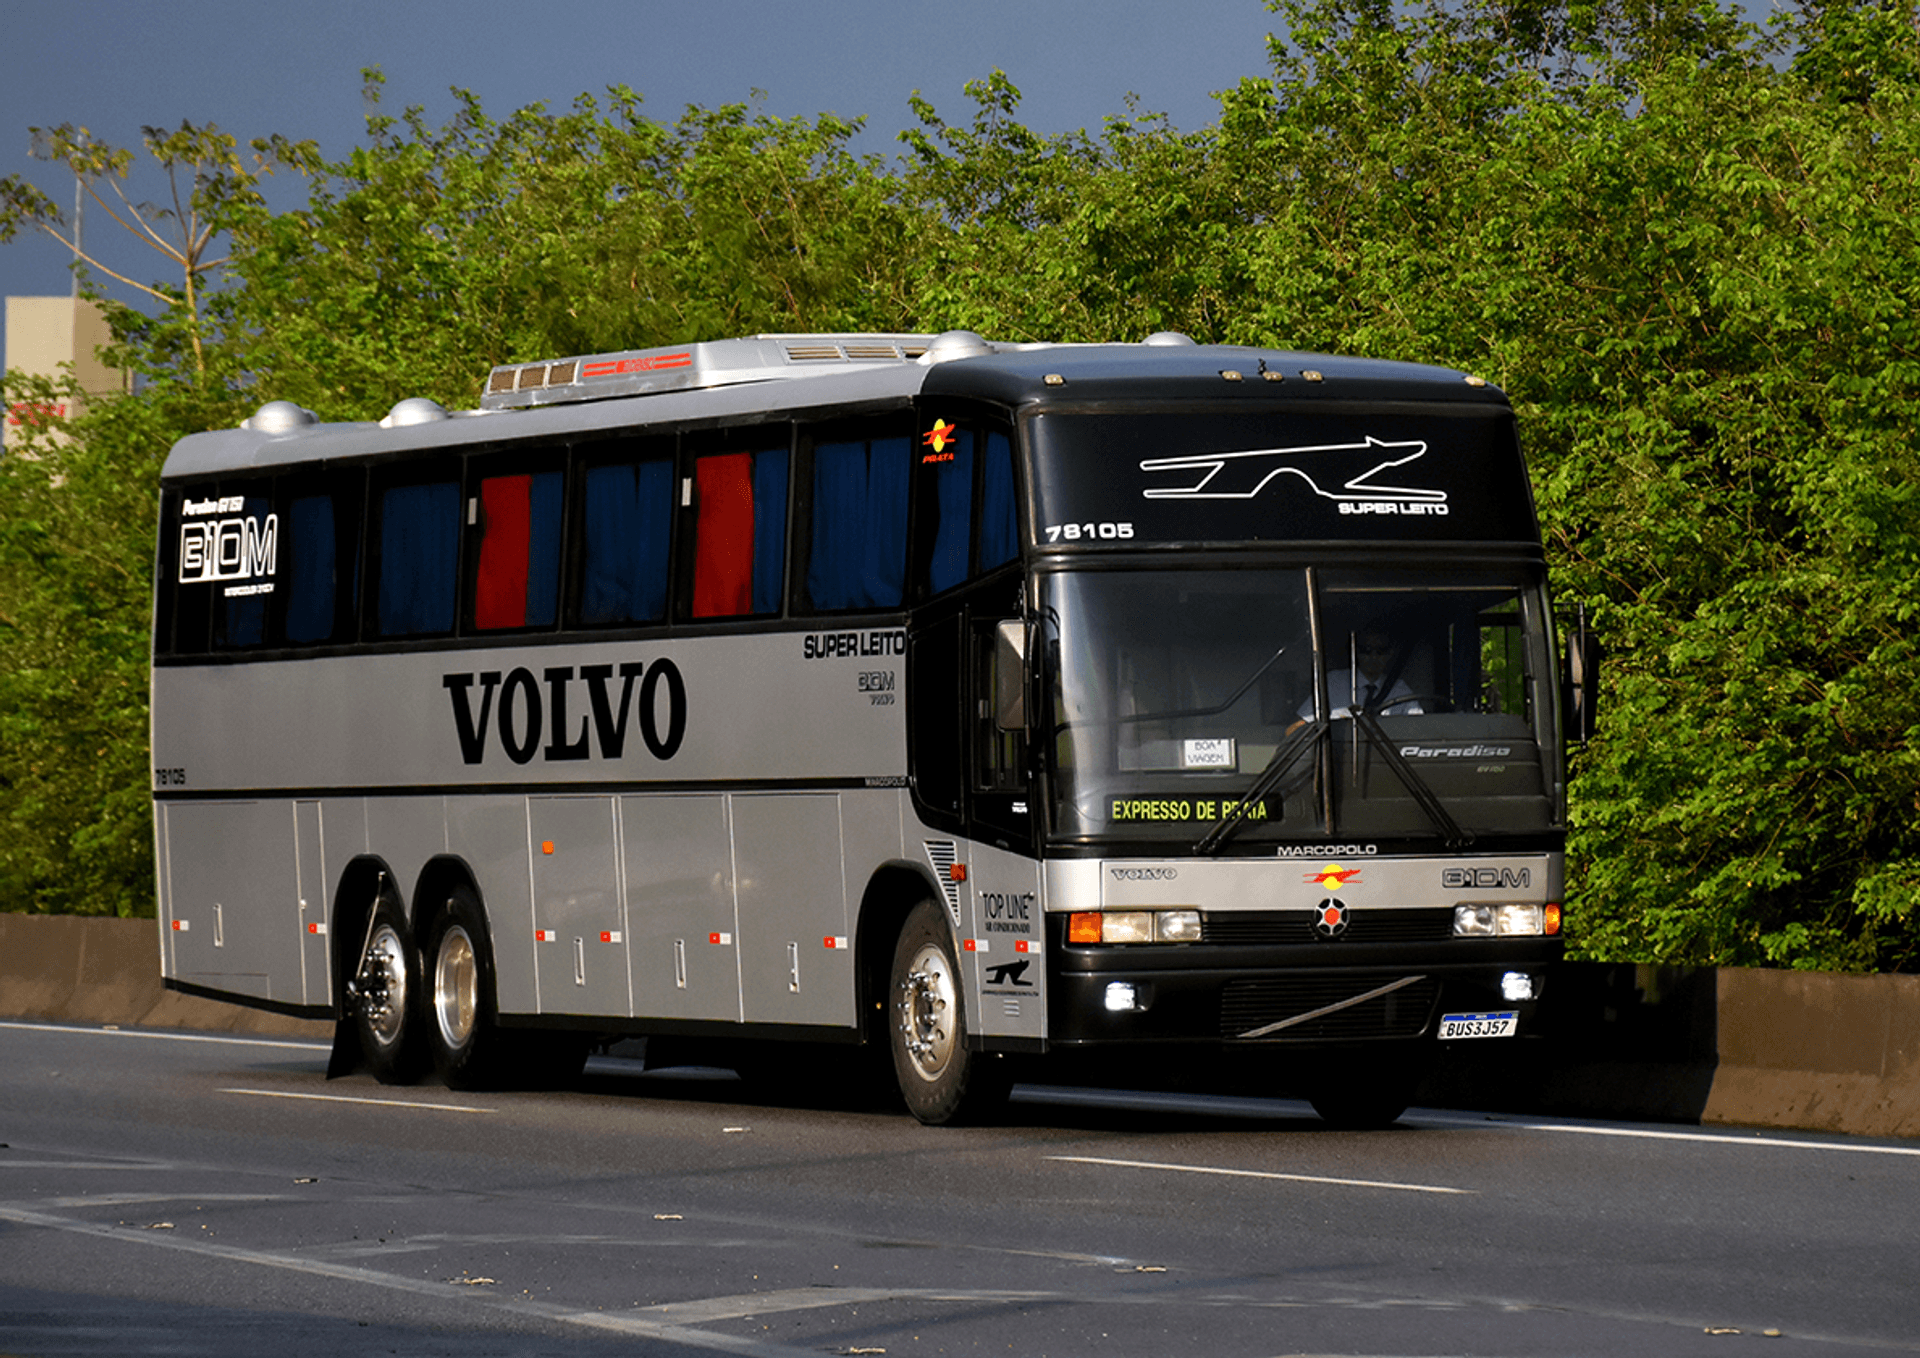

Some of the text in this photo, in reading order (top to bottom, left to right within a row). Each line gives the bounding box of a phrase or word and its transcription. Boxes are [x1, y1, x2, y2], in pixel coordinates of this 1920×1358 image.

[1339, 503, 1449, 515] SUPER LEITO
[1045, 523, 1134, 543] 78105
[179, 513, 278, 584] B10M
[803, 630, 907, 659] SUPER LEITO
[443, 657, 687, 766] VOLVO
[1400, 745, 1511, 758] Paradiso
[155, 767, 186, 785] 78105
[1112, 800, 1190, 820] EXPRESSO
[1196, 800, 1216, 819] DE
[1277, 844, 1378, 857] MARCOPOLO
[1111, 868, 1178, 881] VOLVO
[1442, 867, 1531, 888] B10M
[983, 893, 1029, 920] TOP LINE
[1446, 1020, 1509, 1037] BUS3J57
